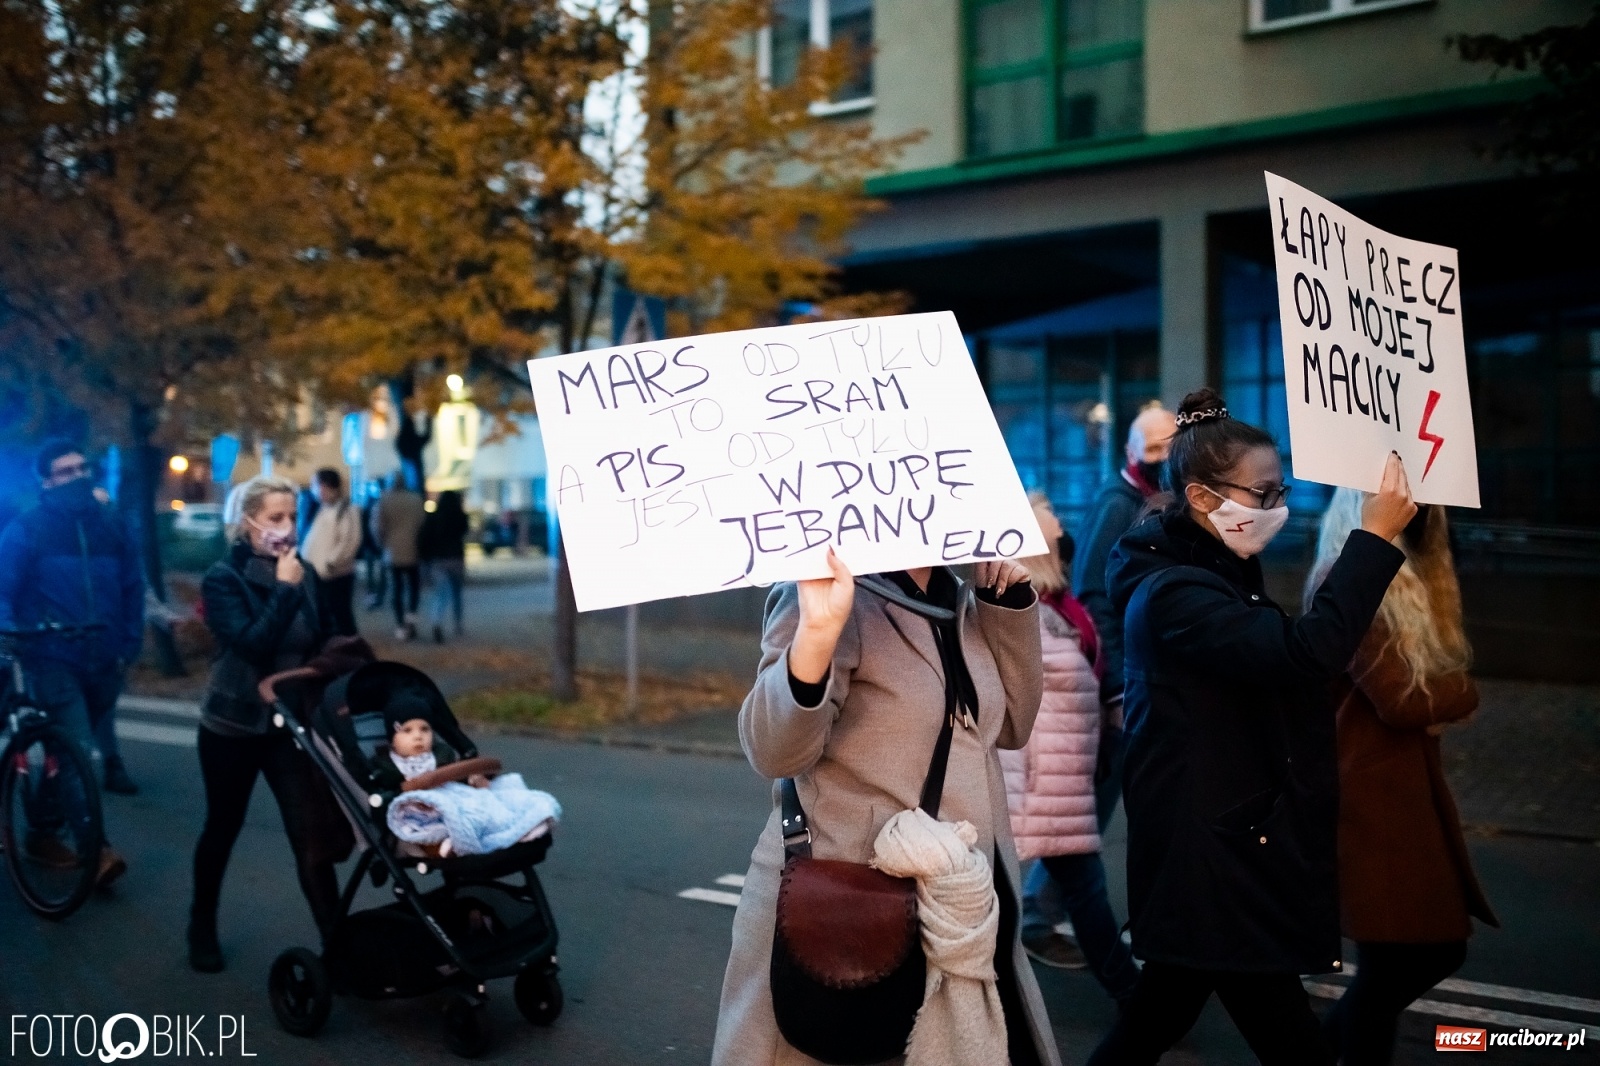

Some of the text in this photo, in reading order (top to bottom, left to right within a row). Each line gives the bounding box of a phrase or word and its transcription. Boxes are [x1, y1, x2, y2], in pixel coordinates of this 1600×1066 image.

[1278, 196, 1456, 316] ŁAPY PRECZ
[1293, 271, 1435, 373] OD MOJEJ
[557, 345, 710, 415] MARS
[742, 342, 800, 377] OD
[648, 373, 909, 439] TO SRAM
[1302, 342, 1401, 432] MACICY
[557, 464, 585, 505] A
[595, 444, 686, 494] PIS
[727, 432, 795, 468] OD
[616, 449, 975, 549] JEST W DUPĘ
[719, 494, 1025, 587] JEBANY ELO
